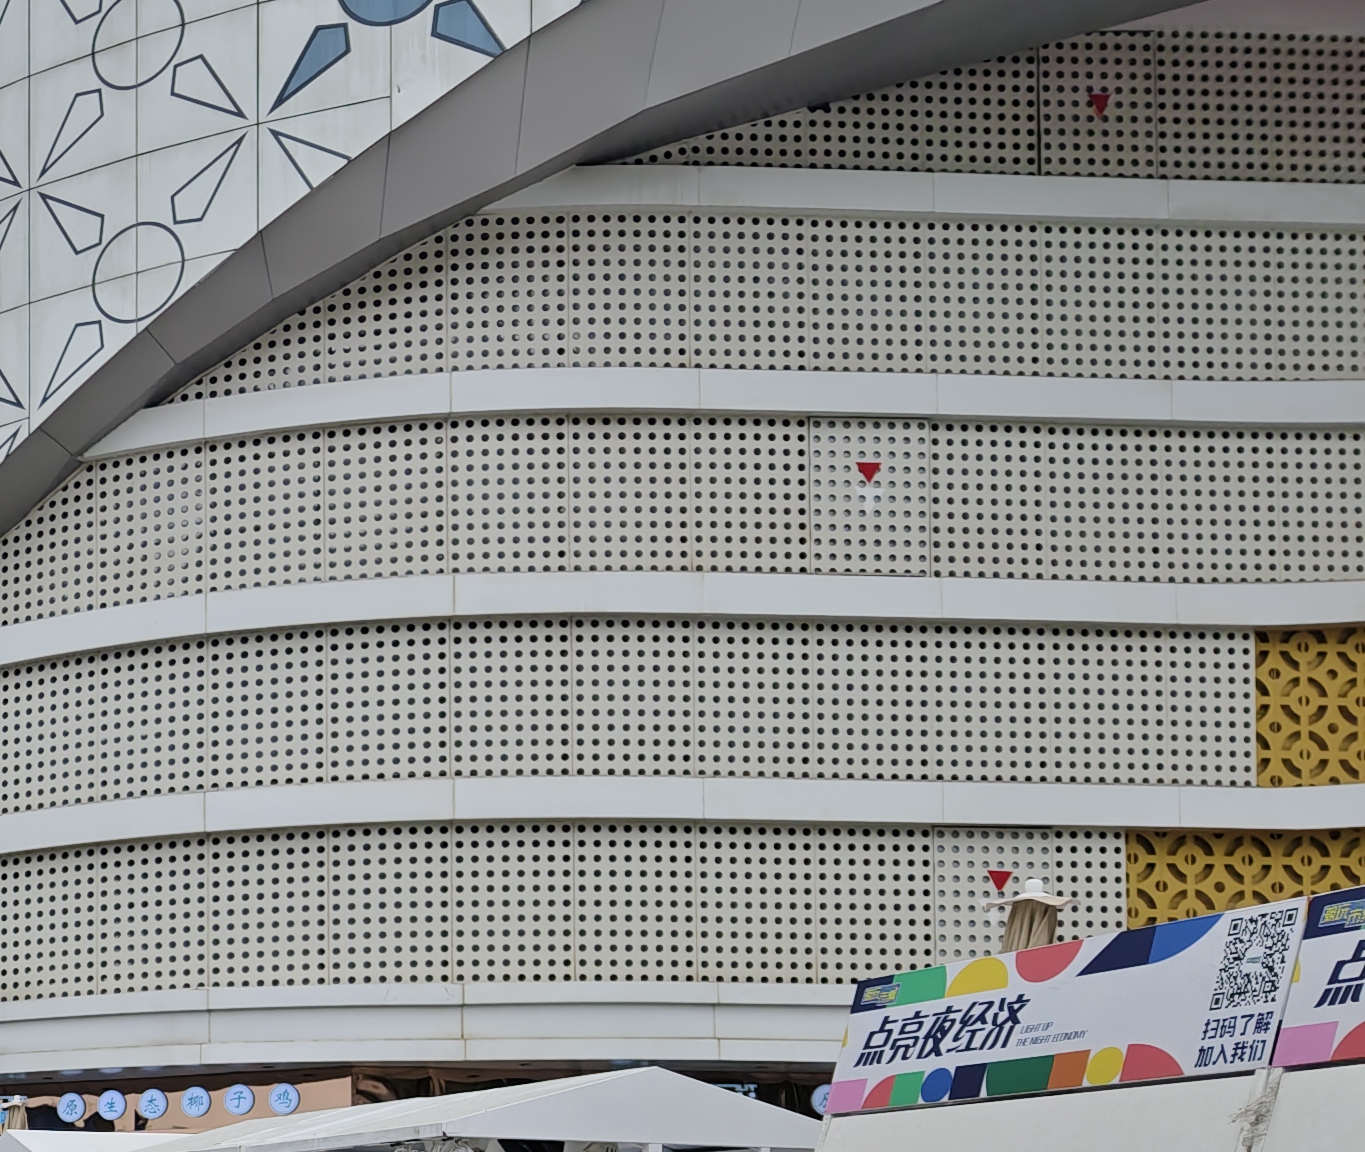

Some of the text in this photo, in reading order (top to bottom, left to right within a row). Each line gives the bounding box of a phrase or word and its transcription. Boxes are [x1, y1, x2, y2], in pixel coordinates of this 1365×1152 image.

[853, 994, 1032, 1067] 点亮夜经济
[1201, 1011, 1275, 1040] 扫码了解
[1194, 1039, 1267, 1068] 加入我们
[60, 1086, 296, 1119] 原生态椰子鸡
